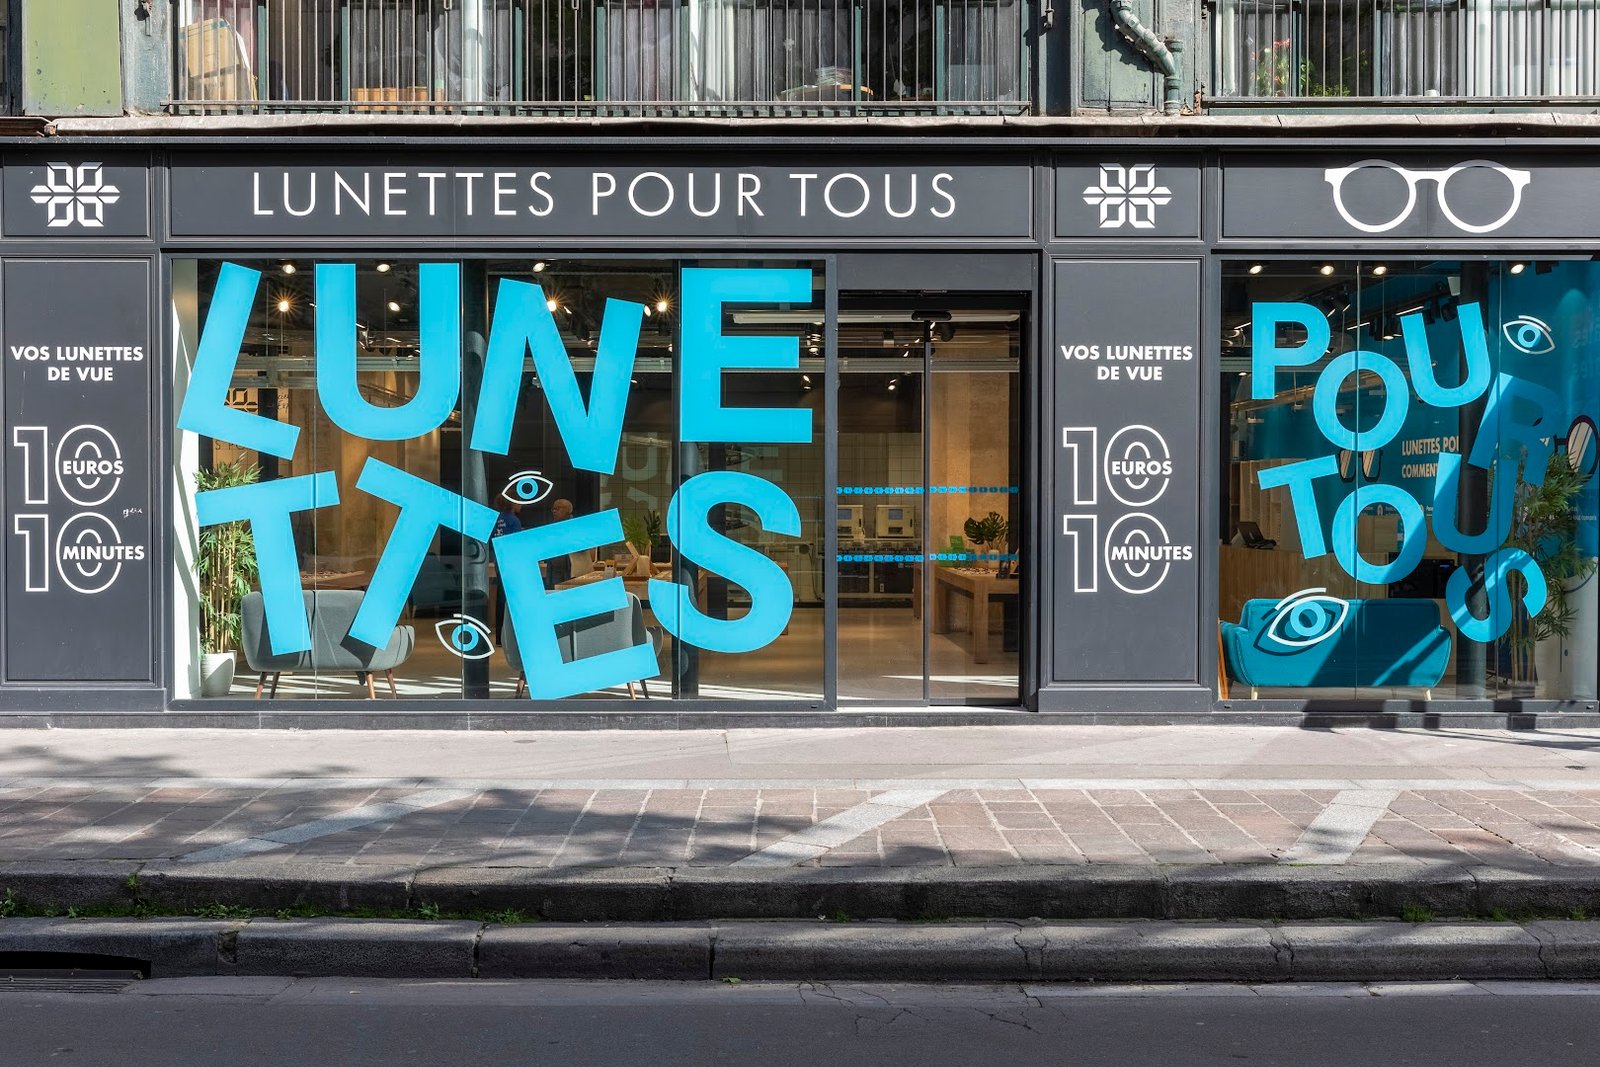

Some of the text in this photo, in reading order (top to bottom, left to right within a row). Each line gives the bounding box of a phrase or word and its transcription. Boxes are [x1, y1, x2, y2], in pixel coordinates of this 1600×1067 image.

[253, 171, 956, 218] LUNETTES POUR TOUS
[11, 346, 143, 361] VOS LUNETTES
[47, 367, 113, 381] DE VUE
[1061, 345, 1193, 360] VOS LUNETTES
[1097, 366, 1163, 381] DE VUE
[1251, 301, 1559, 488] POUR
[13, 424, 124, 507] 10 EUROS
[1063, 424, 1173, 507] 10 EUROS
[1402, 438, 1441, 456] LUNETTES
[14, 511, 145, 594] 10 MINUTES
[1063, 512, 1193, 595] 10 MINUTES
[1257, 452, 1548, 643] TOUS
